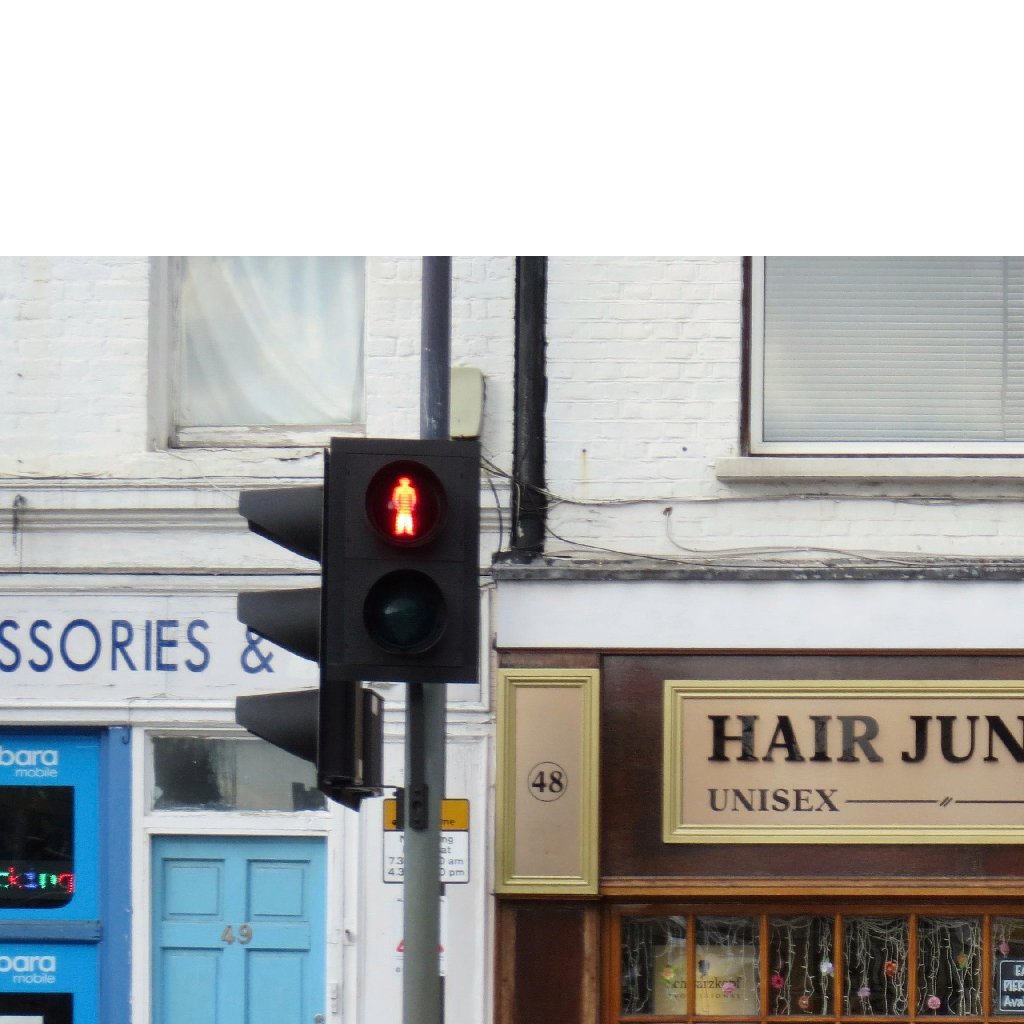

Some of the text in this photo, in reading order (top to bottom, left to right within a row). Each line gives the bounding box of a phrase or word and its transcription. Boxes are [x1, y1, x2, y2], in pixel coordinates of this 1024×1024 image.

[0, 618, 275, 674] SSORIES &
[707, 715, 884, 763] HAIR
[15, 767, 58, 778] mobile
[531, 770, 564, 794] 48
[708, 788, 840, 812] UNISEX
[449, 869, 465, 877] pm
[221, 924, 253, 945] 49
[13, 973, 56, 984] mobile
